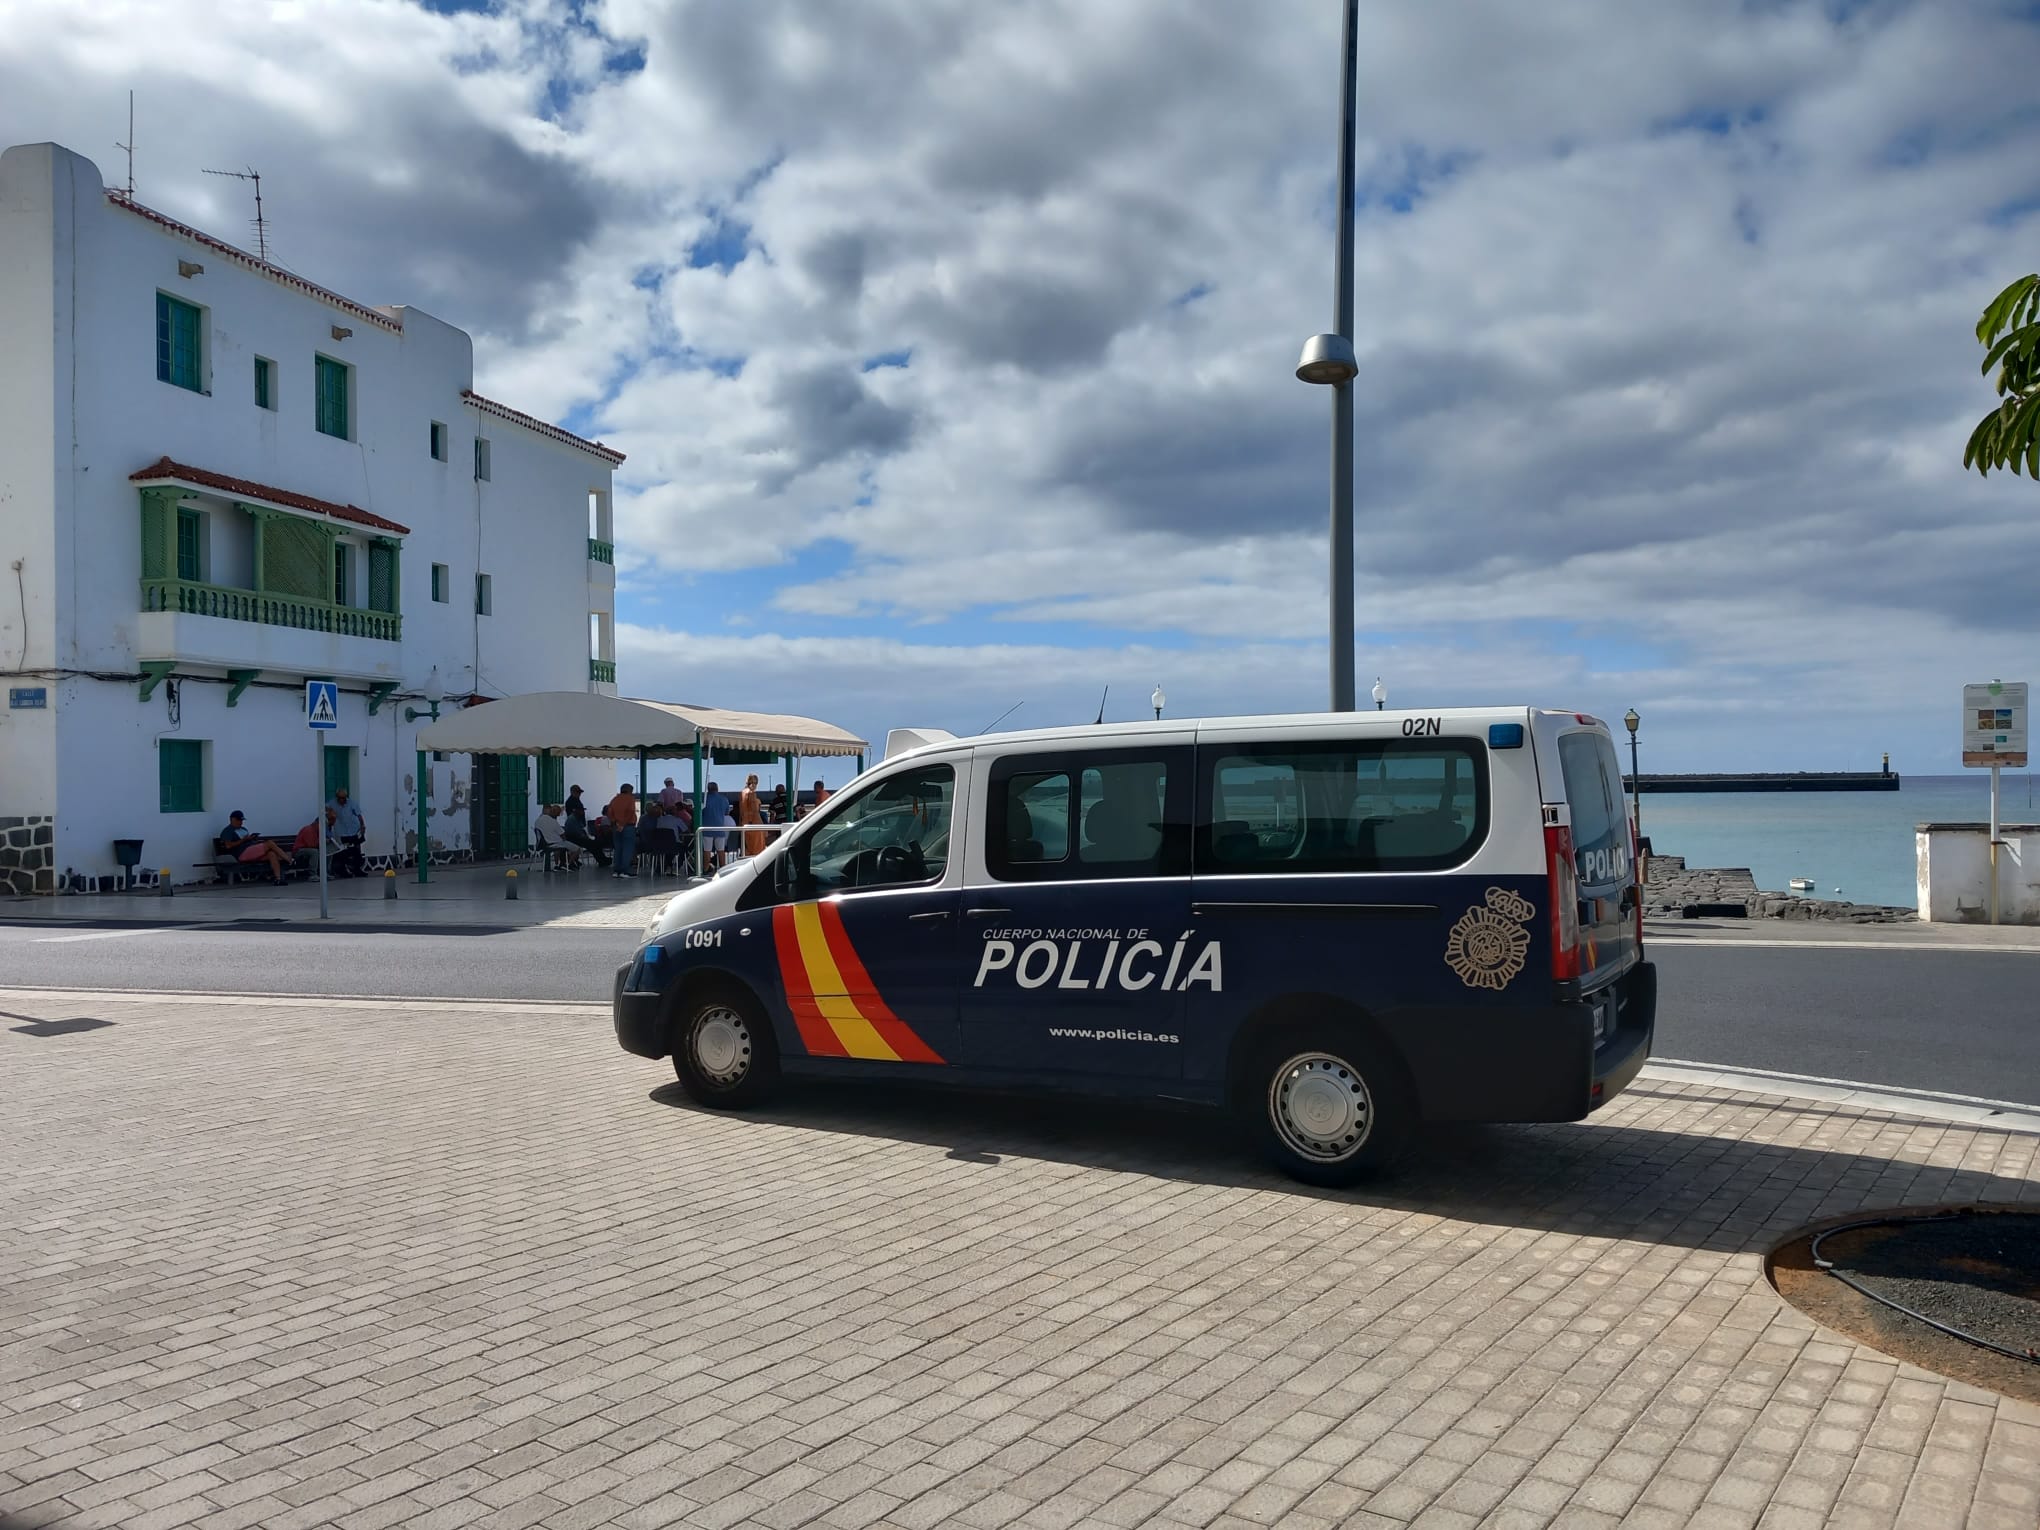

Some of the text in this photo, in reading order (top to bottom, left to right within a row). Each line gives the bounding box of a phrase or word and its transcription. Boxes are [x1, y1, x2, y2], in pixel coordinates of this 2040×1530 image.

[1402, 717, 1441, 736] 02N
[693, 930, 722, 947] 091
[982, 928, 1149, 939] CUERPO NACIONAL DE
[973, 929, 1223, 992] POLICÍA
[1049, 1027, 1180, 1043] www.policia.es
